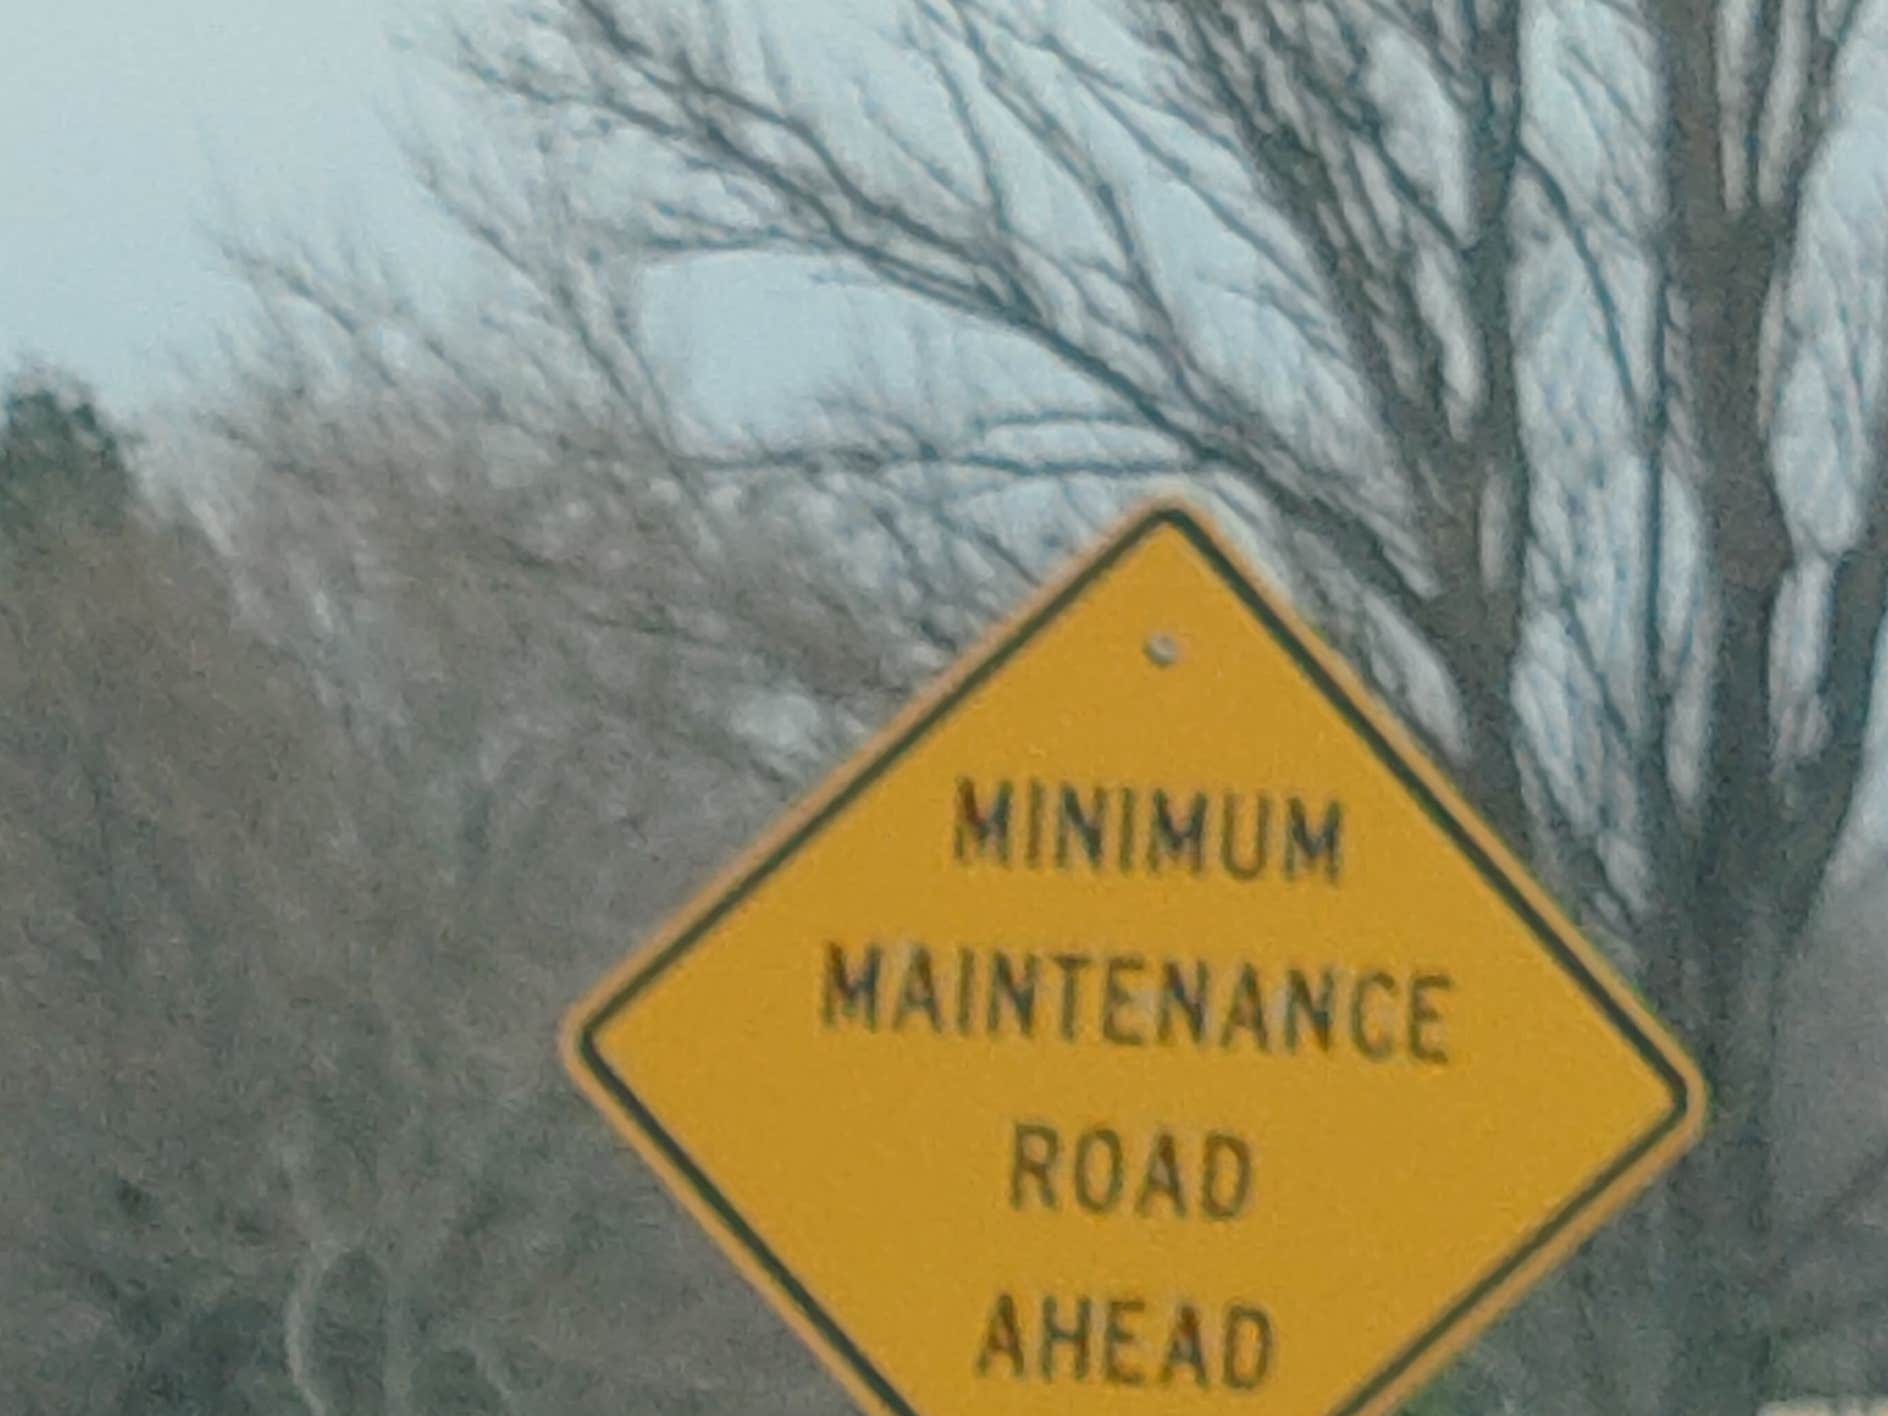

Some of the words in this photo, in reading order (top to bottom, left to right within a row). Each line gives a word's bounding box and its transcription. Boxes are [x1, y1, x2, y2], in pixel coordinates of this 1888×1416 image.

[954, 778, 1344, 886] MINIMUM
[820, 942, 1452, 1064] MAINTENANCE
[1007, 1122, 1255, 1220] ROAD
[975, 1294, 1276, 1392] AHEAD
